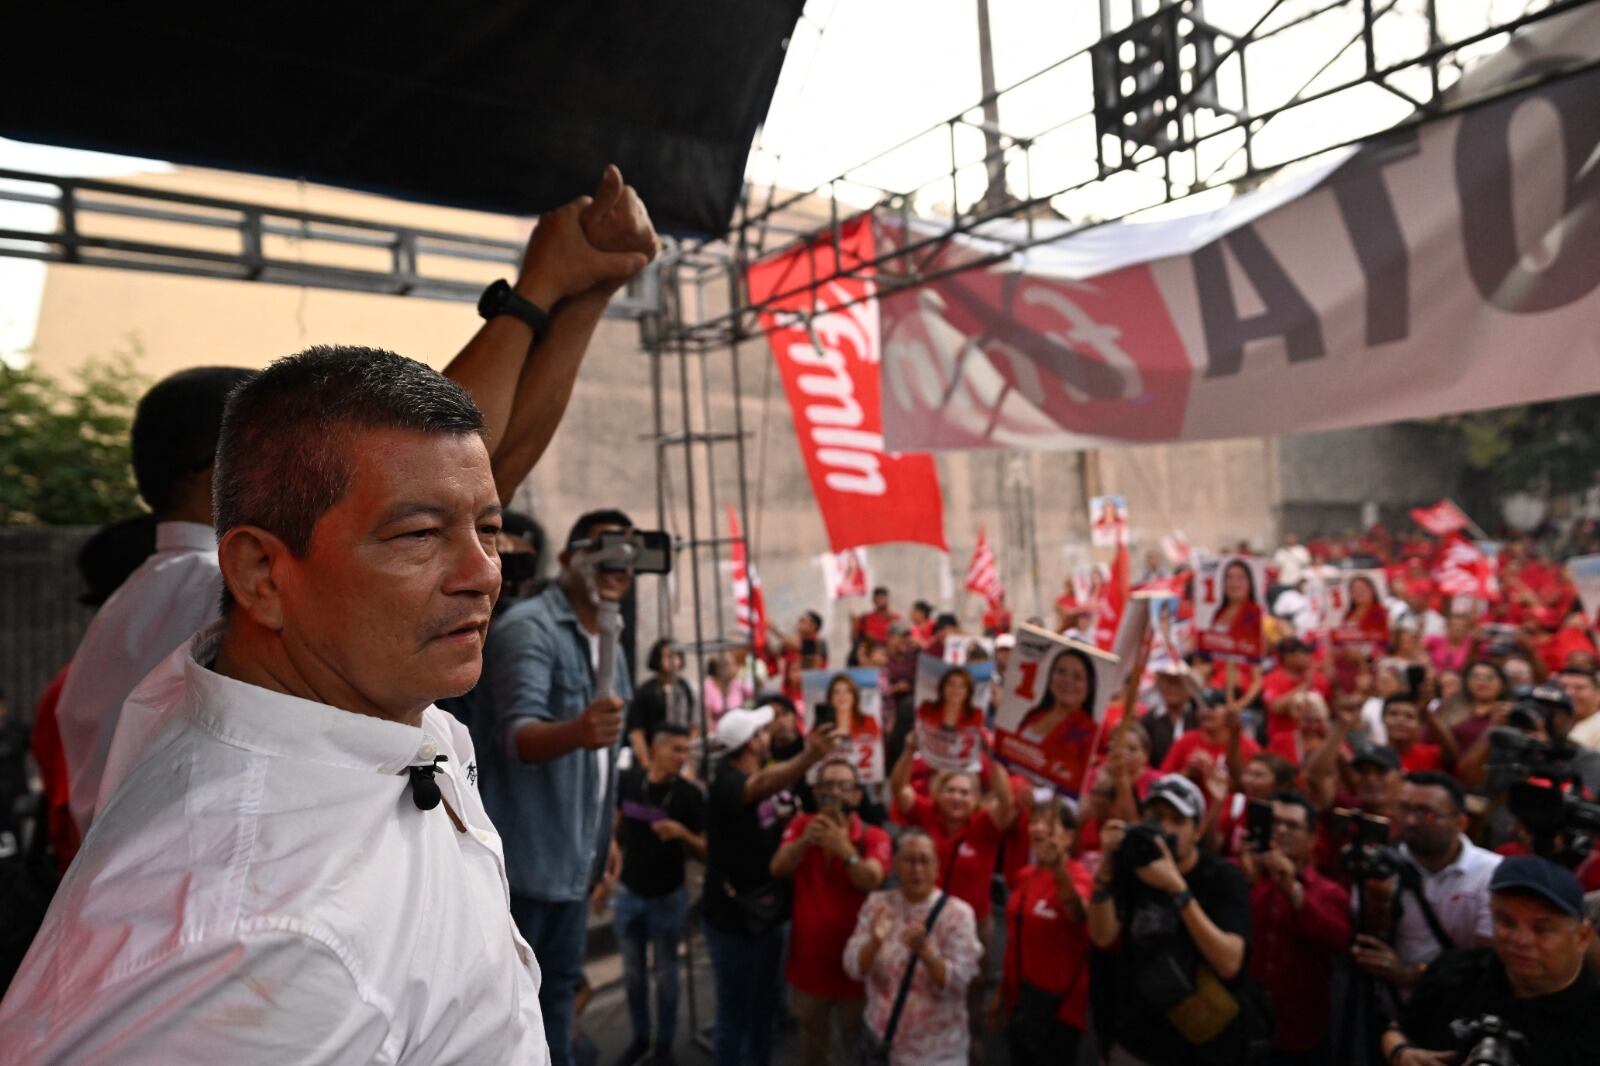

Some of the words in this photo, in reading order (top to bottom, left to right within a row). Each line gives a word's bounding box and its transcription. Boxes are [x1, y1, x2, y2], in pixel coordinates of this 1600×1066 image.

[1014, 660, 1038, 701] 1
[857, 745, 874, 769] 2
[958, 736, 976, 759] 2
